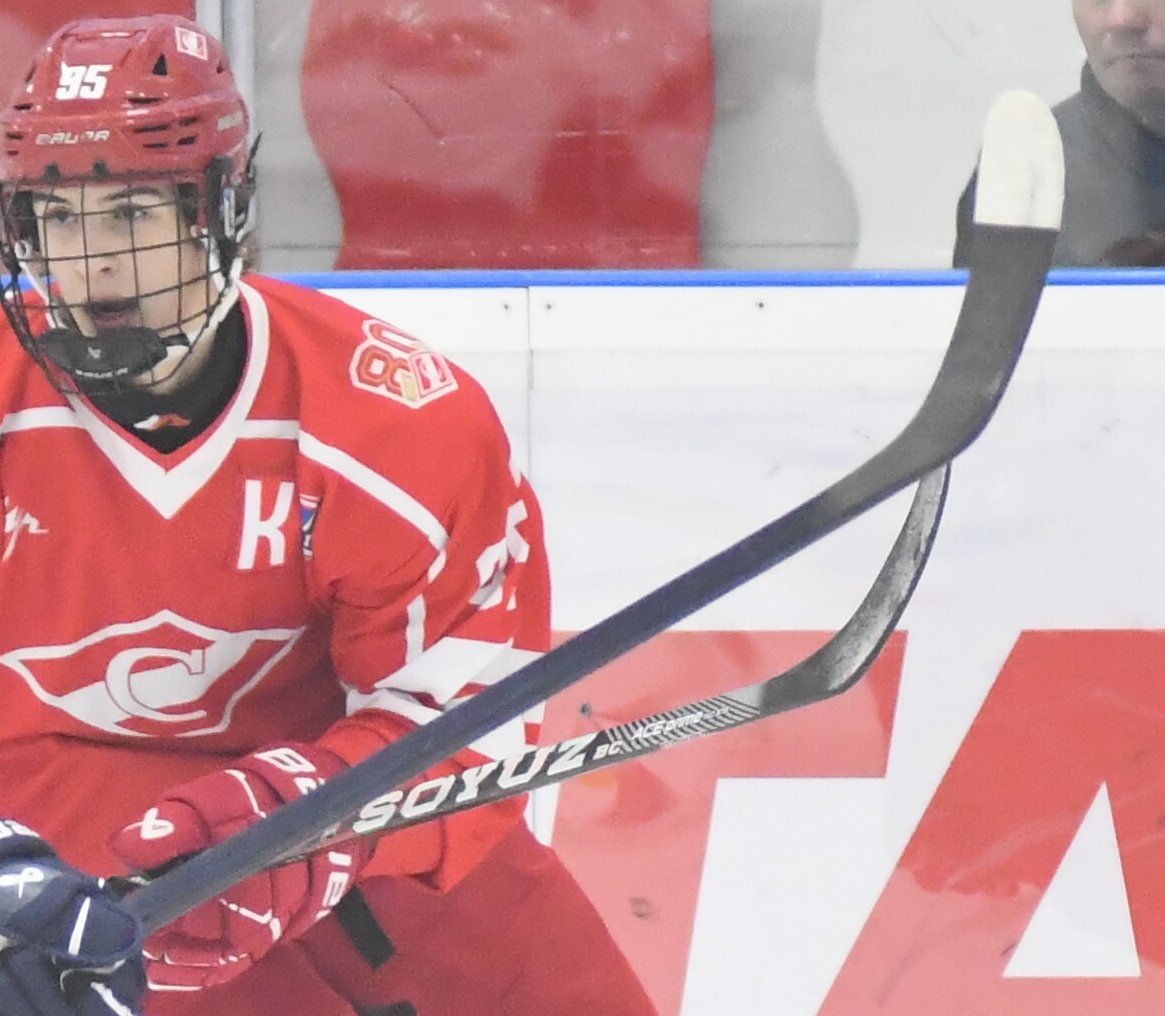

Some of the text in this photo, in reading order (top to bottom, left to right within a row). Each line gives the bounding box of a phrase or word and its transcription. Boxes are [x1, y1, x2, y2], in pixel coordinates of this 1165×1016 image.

[56, 62, 113, 100] 95
[237, 479, 295, 570] K
[352, 732, 599, 834] SOYUZ
